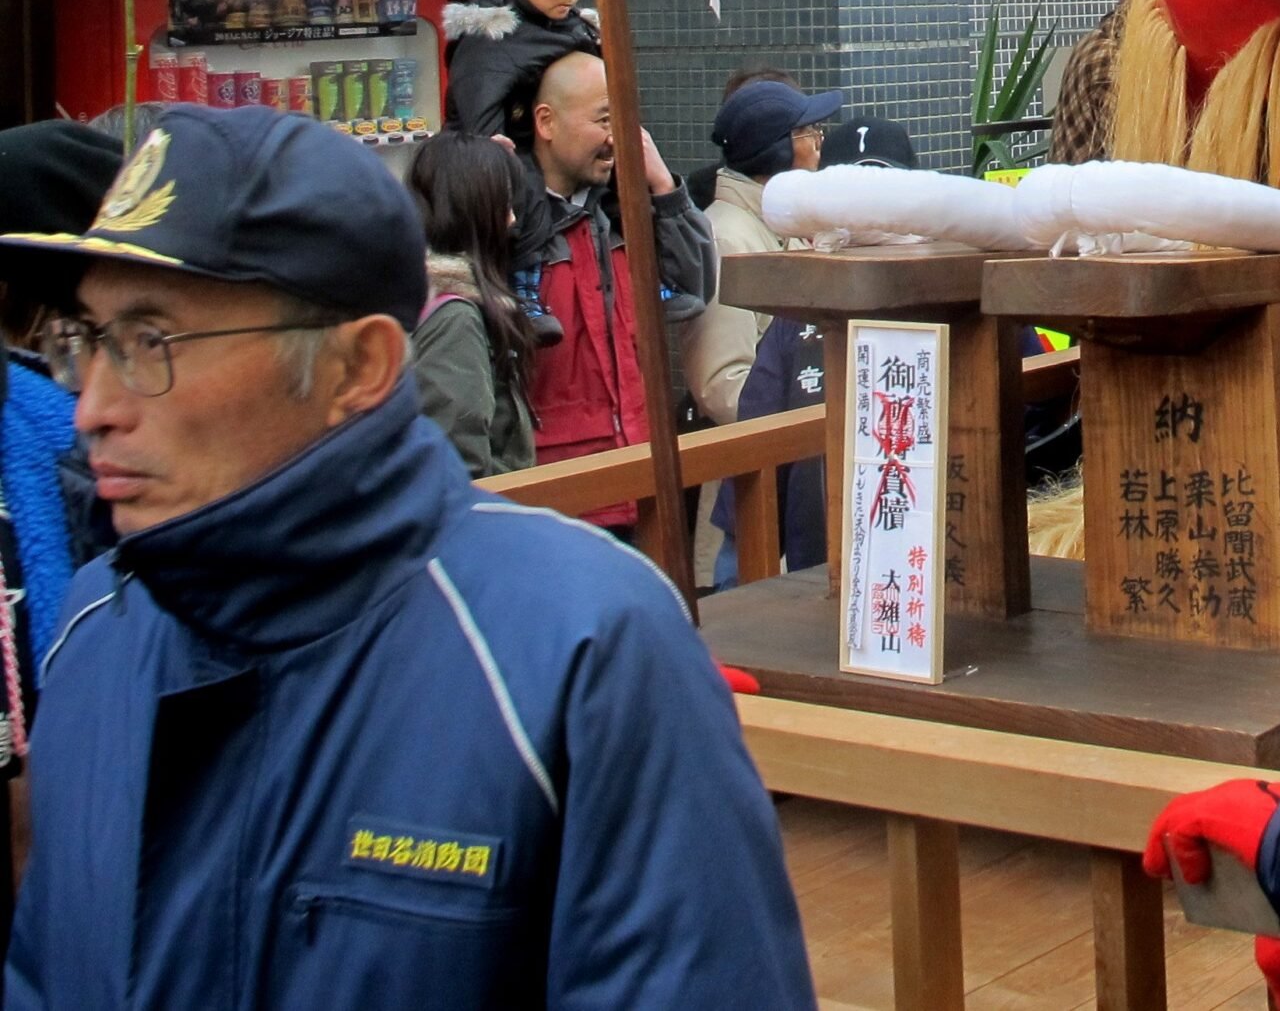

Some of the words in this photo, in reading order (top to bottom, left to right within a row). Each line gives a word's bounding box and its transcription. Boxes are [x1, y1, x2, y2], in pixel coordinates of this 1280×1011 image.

[857, 344, 871, 438] 開運満足
[915, 349, 933, 445] 商売繁盛
[1154, 392, 1204, 443] 納
[1153, 470, 1184, 614] 上原勝久
[878, 568, 901, 654] 大雄山
